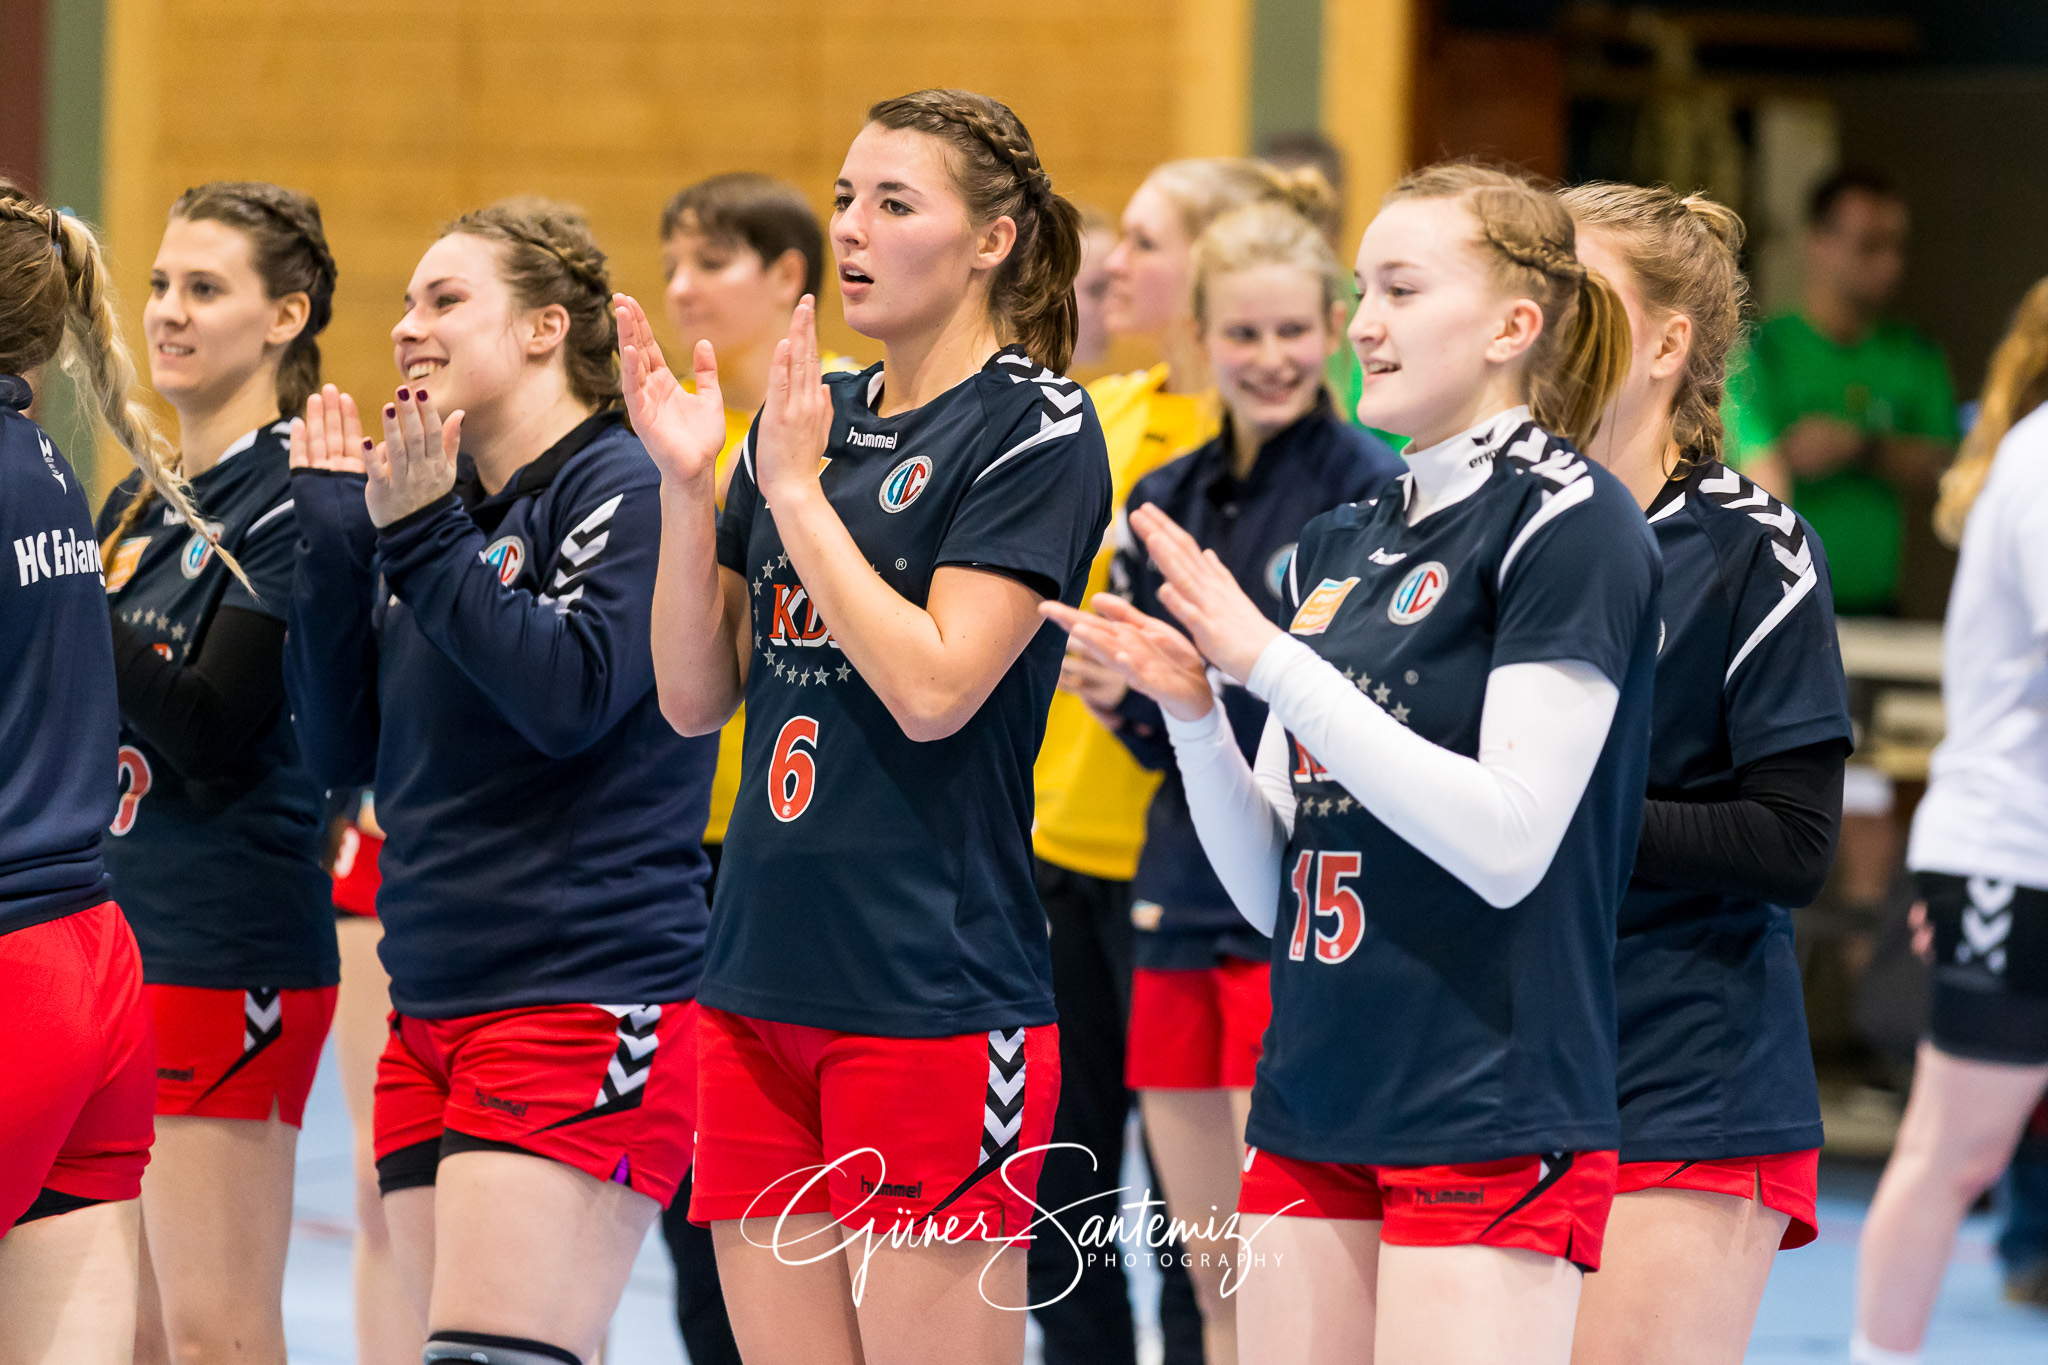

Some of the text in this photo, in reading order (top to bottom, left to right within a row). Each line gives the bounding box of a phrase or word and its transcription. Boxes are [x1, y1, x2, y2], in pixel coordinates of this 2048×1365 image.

[846, 426, 898, 450] hummel
[13, 532, 52, 587] HC
[769, 584, 841, 648] KD
[768, 715, 819, 823] 6
[1289, 849, 1366, 965] 15
[474, 1086, 528, 1117] hummel
[861, 1174, 922, 1199] hummel
[1416, 1185, 1484, 1205] hummel
